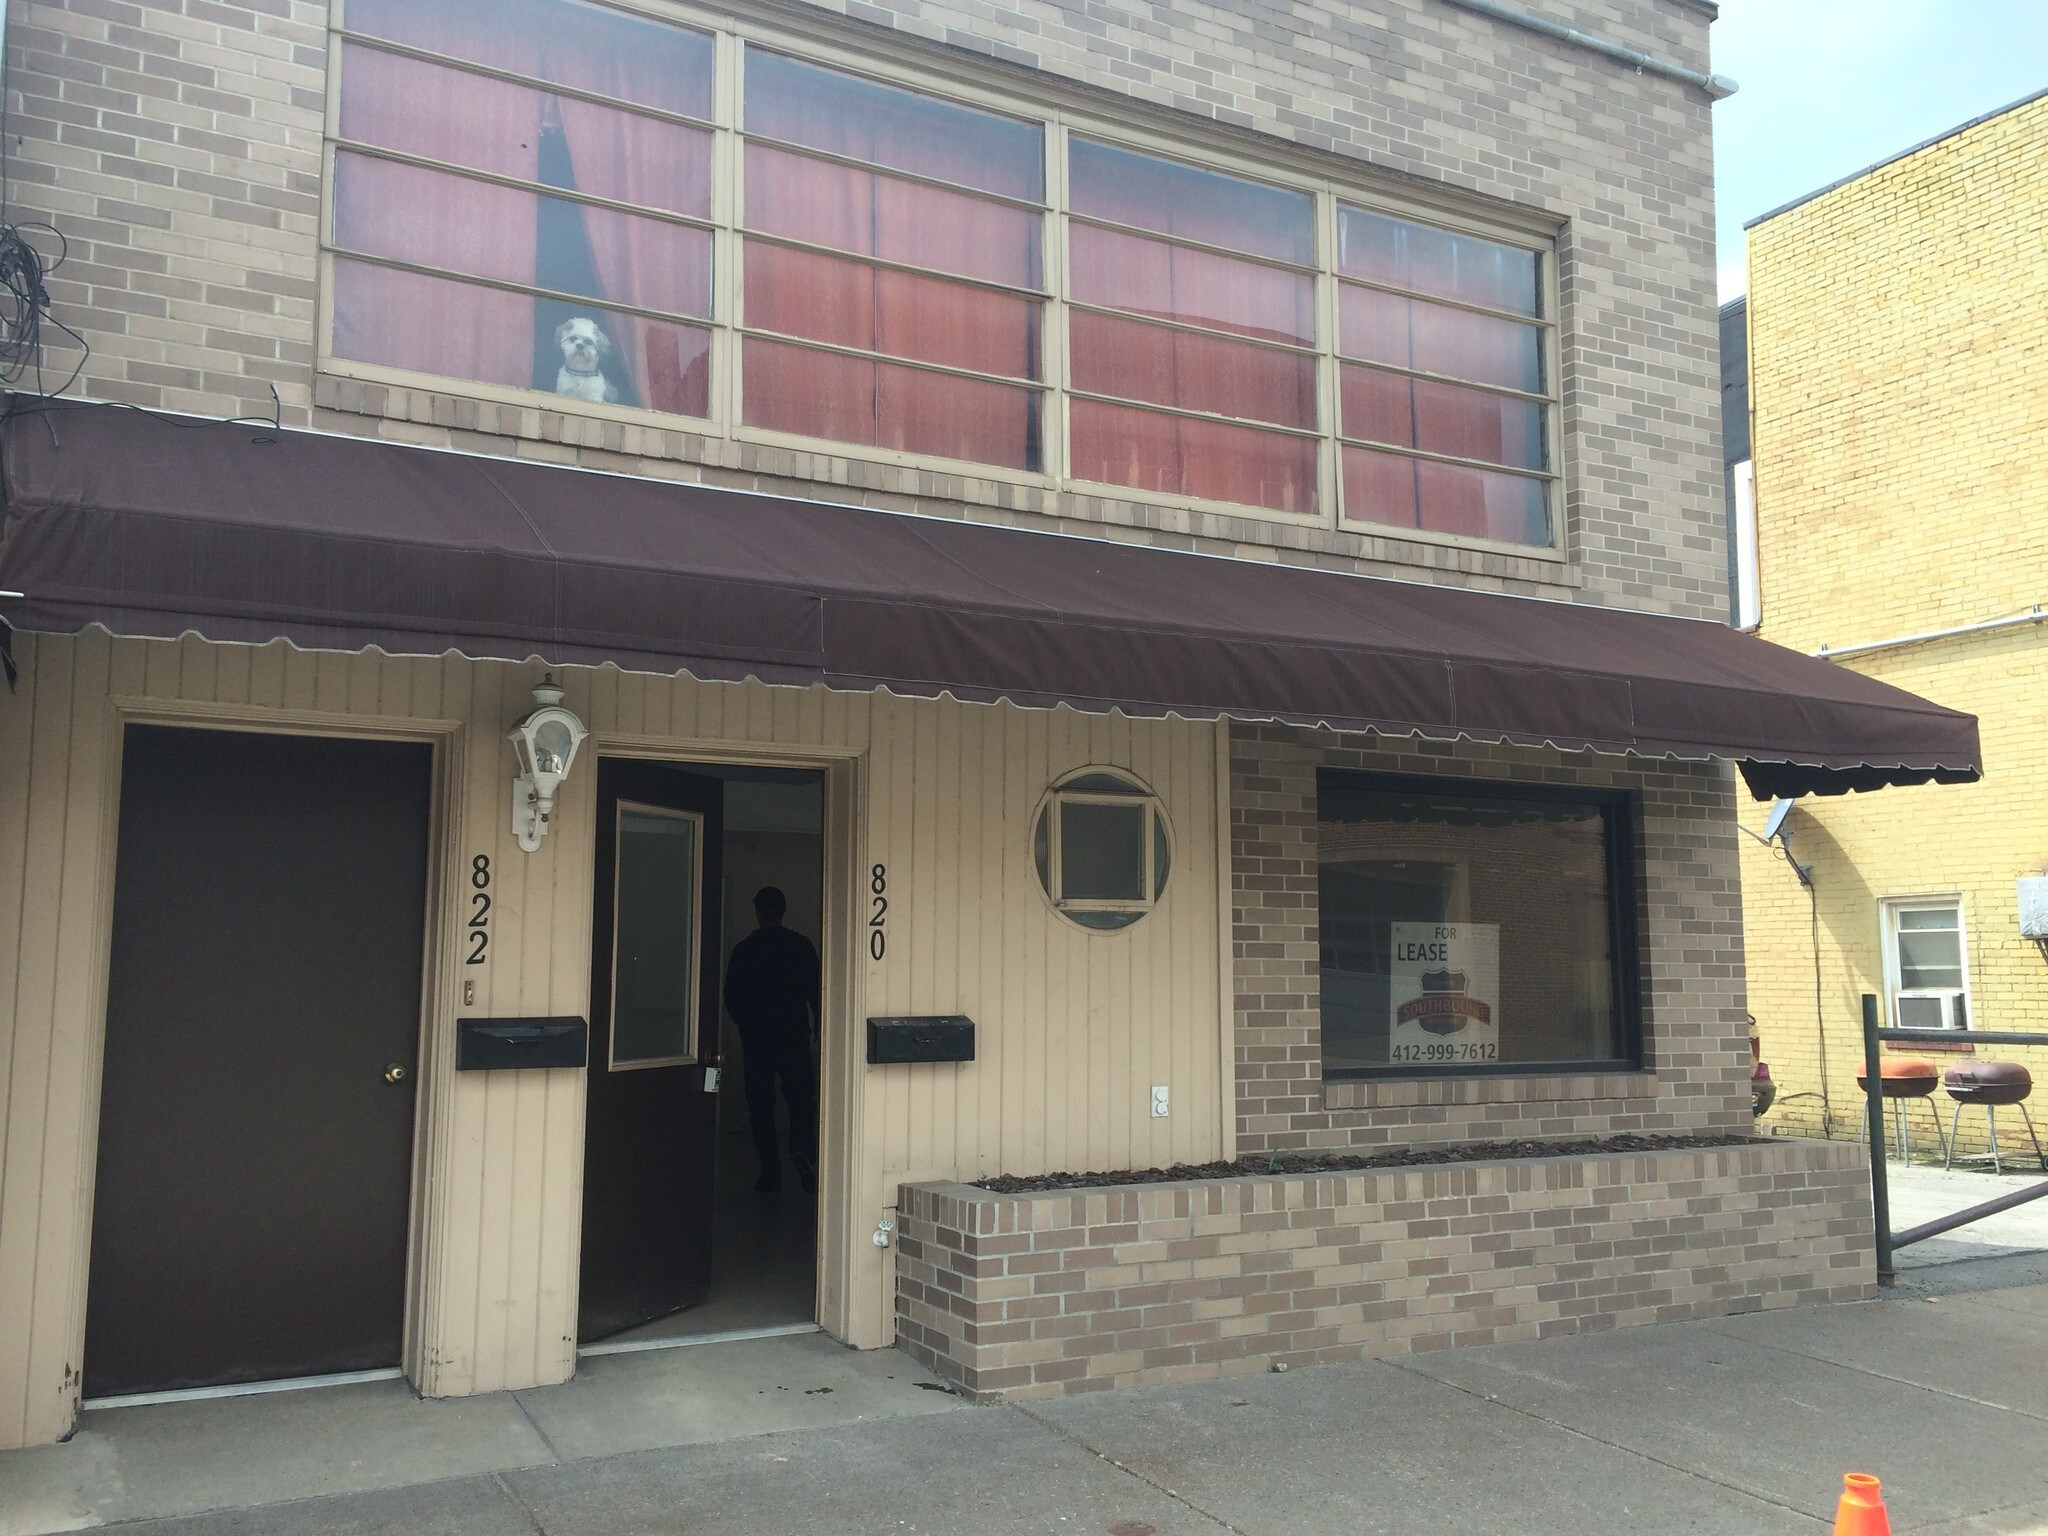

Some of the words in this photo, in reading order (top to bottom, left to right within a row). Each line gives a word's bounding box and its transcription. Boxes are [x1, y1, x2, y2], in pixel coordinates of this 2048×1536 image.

[466, 854, 491, 965] 822
[869, 863, 888, 961] 820
[1435, 927, 1457, 940] FOR
[1397, 943, 1448, 962] LEASE
[1392, 1043, 1496, 1061] 412-999-7612
